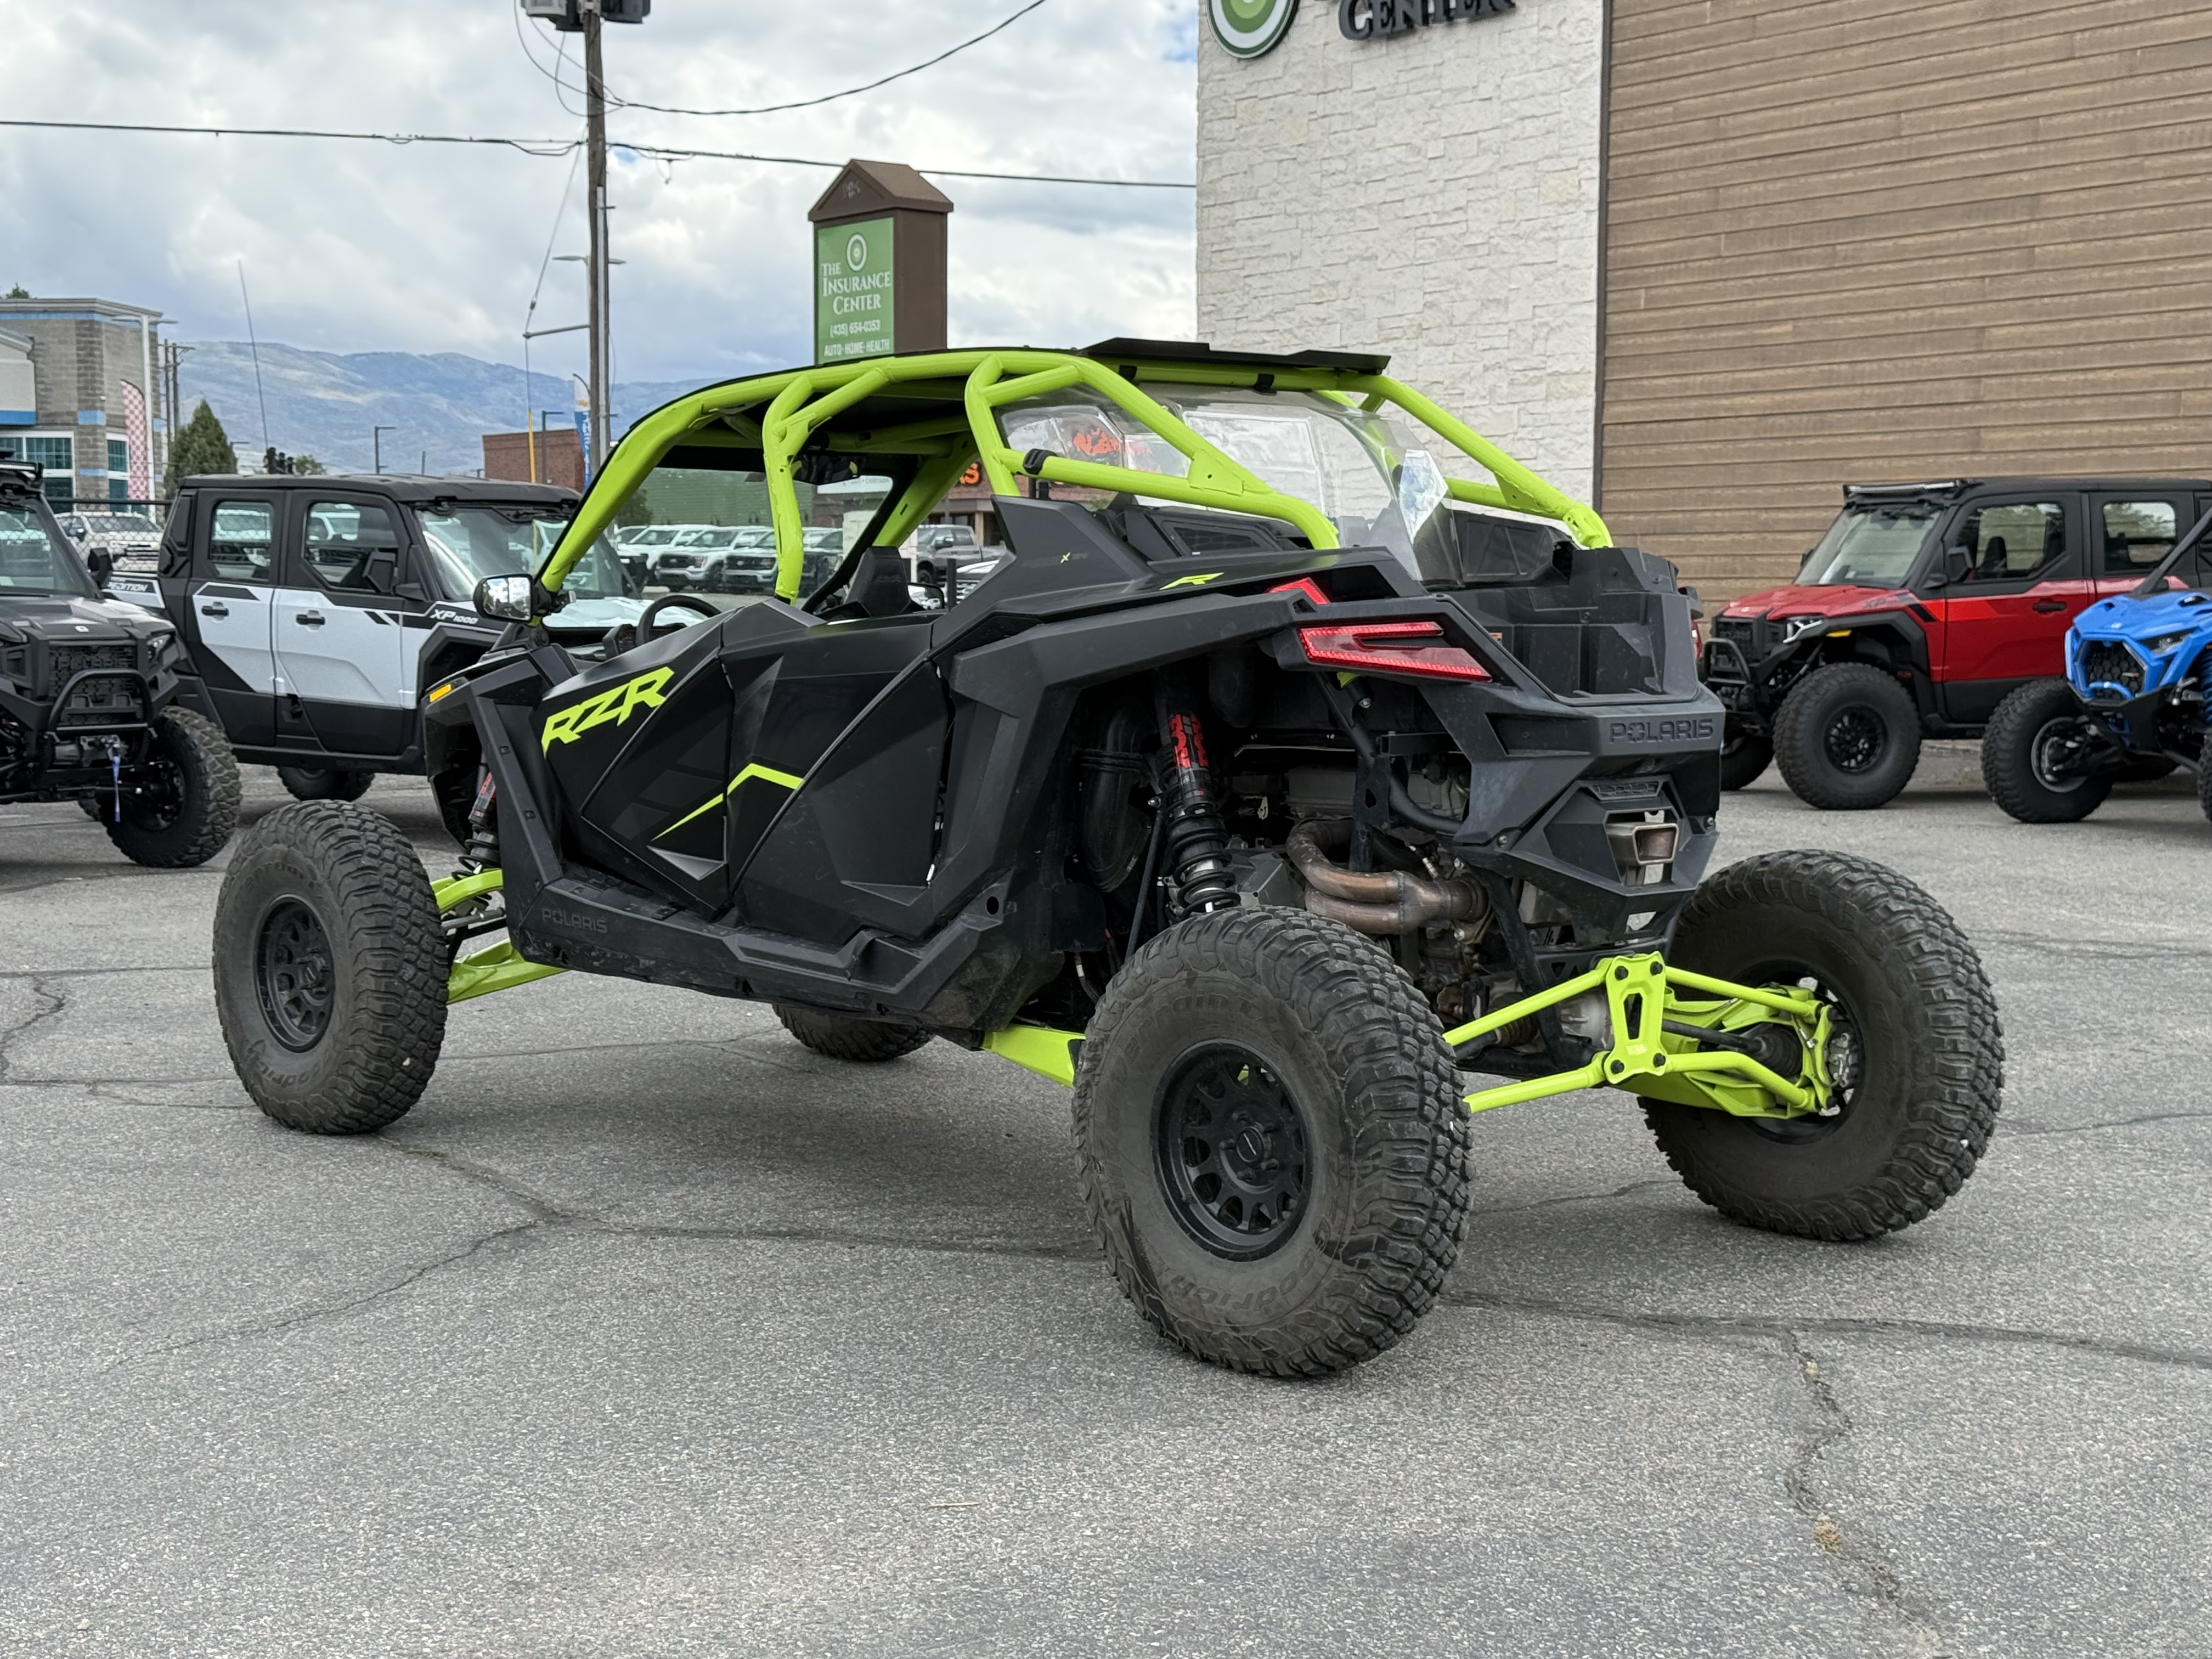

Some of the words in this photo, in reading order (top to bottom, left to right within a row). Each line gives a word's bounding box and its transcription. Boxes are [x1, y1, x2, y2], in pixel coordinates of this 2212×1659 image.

[822, 262, 842, 276] THE
[823, 271, 891, 296] INSURANCE
[833, 294, 881, 315] CENTER
[430, 609, 456, 620] XP
[453, 615, 479, 625] 1000
[541, 666, 675, 760] RZR
[1610, 718, 1714, 744] POLARIS
[541, 907, 608, 933] POLARIS
